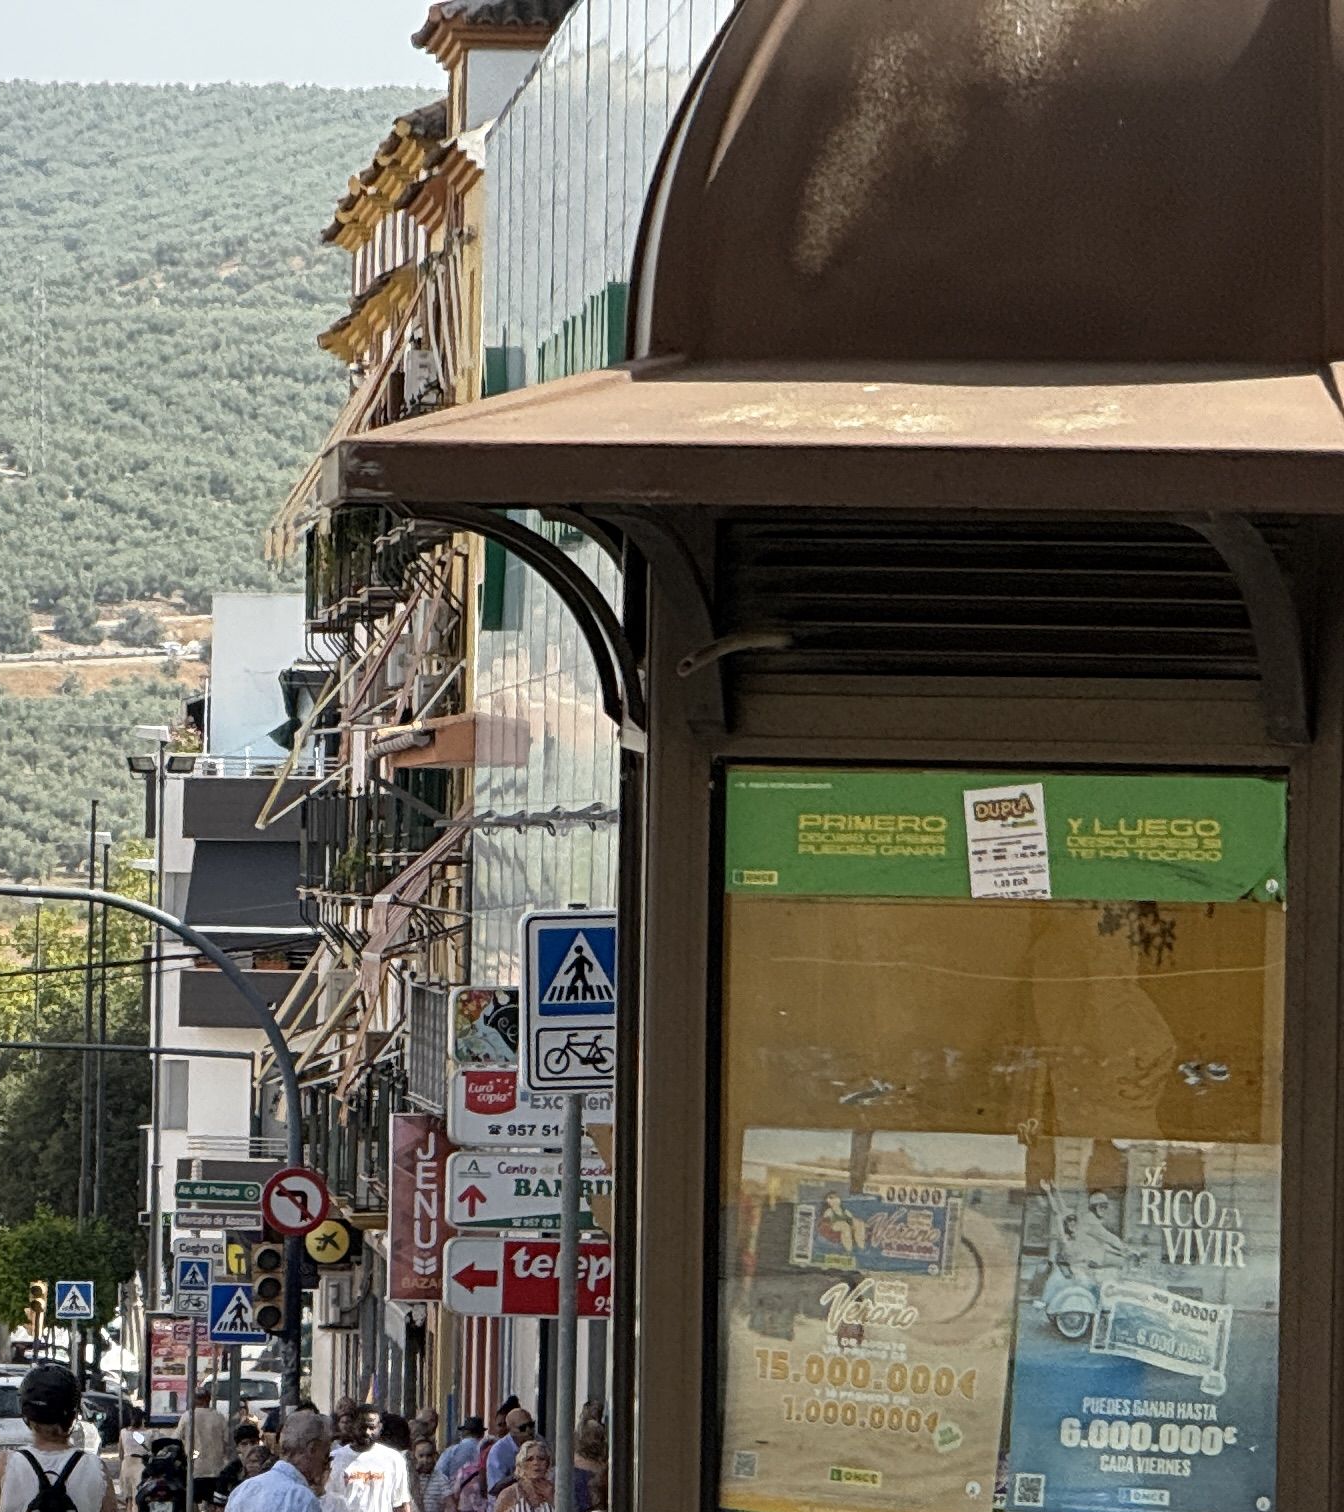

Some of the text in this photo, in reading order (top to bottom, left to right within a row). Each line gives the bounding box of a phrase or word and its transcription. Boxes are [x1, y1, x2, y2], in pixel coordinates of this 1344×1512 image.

[974, 794, 1033, 821] DUPLA
[798, 814, 947, 831] PRIMERO
[1068, 818, 1220, 836] Y LUEGO
[880, 844, 946, 856] GANAR
[507, 1124, 536, 1137] 957
[498, 1161, 537, 1175] Centro
[1143, 1161, 1166, 1187] SÉ
[214, 1214, 224, 1225] de
[1140, 1188, 1217, 1228] RICO
[179, 1243, 209, 1255] Centro
[1162, 1228, 1246, 1268] VIVIR
[820, 1278, 919, 1333] Verano
[755, 1349, 977, 1399] 15.000.000€
[783, 1397, 939, 1434] 1.000.000€
[1083, 1397, 1218, 1422] PUEDES GANAR HASTA
[1060, 1417, 1238, 1456] 6.000.000€
[1100, 1455, 1191, 1477] CADA VIERNES
[843, 1471, 879, 1485] ONCE
